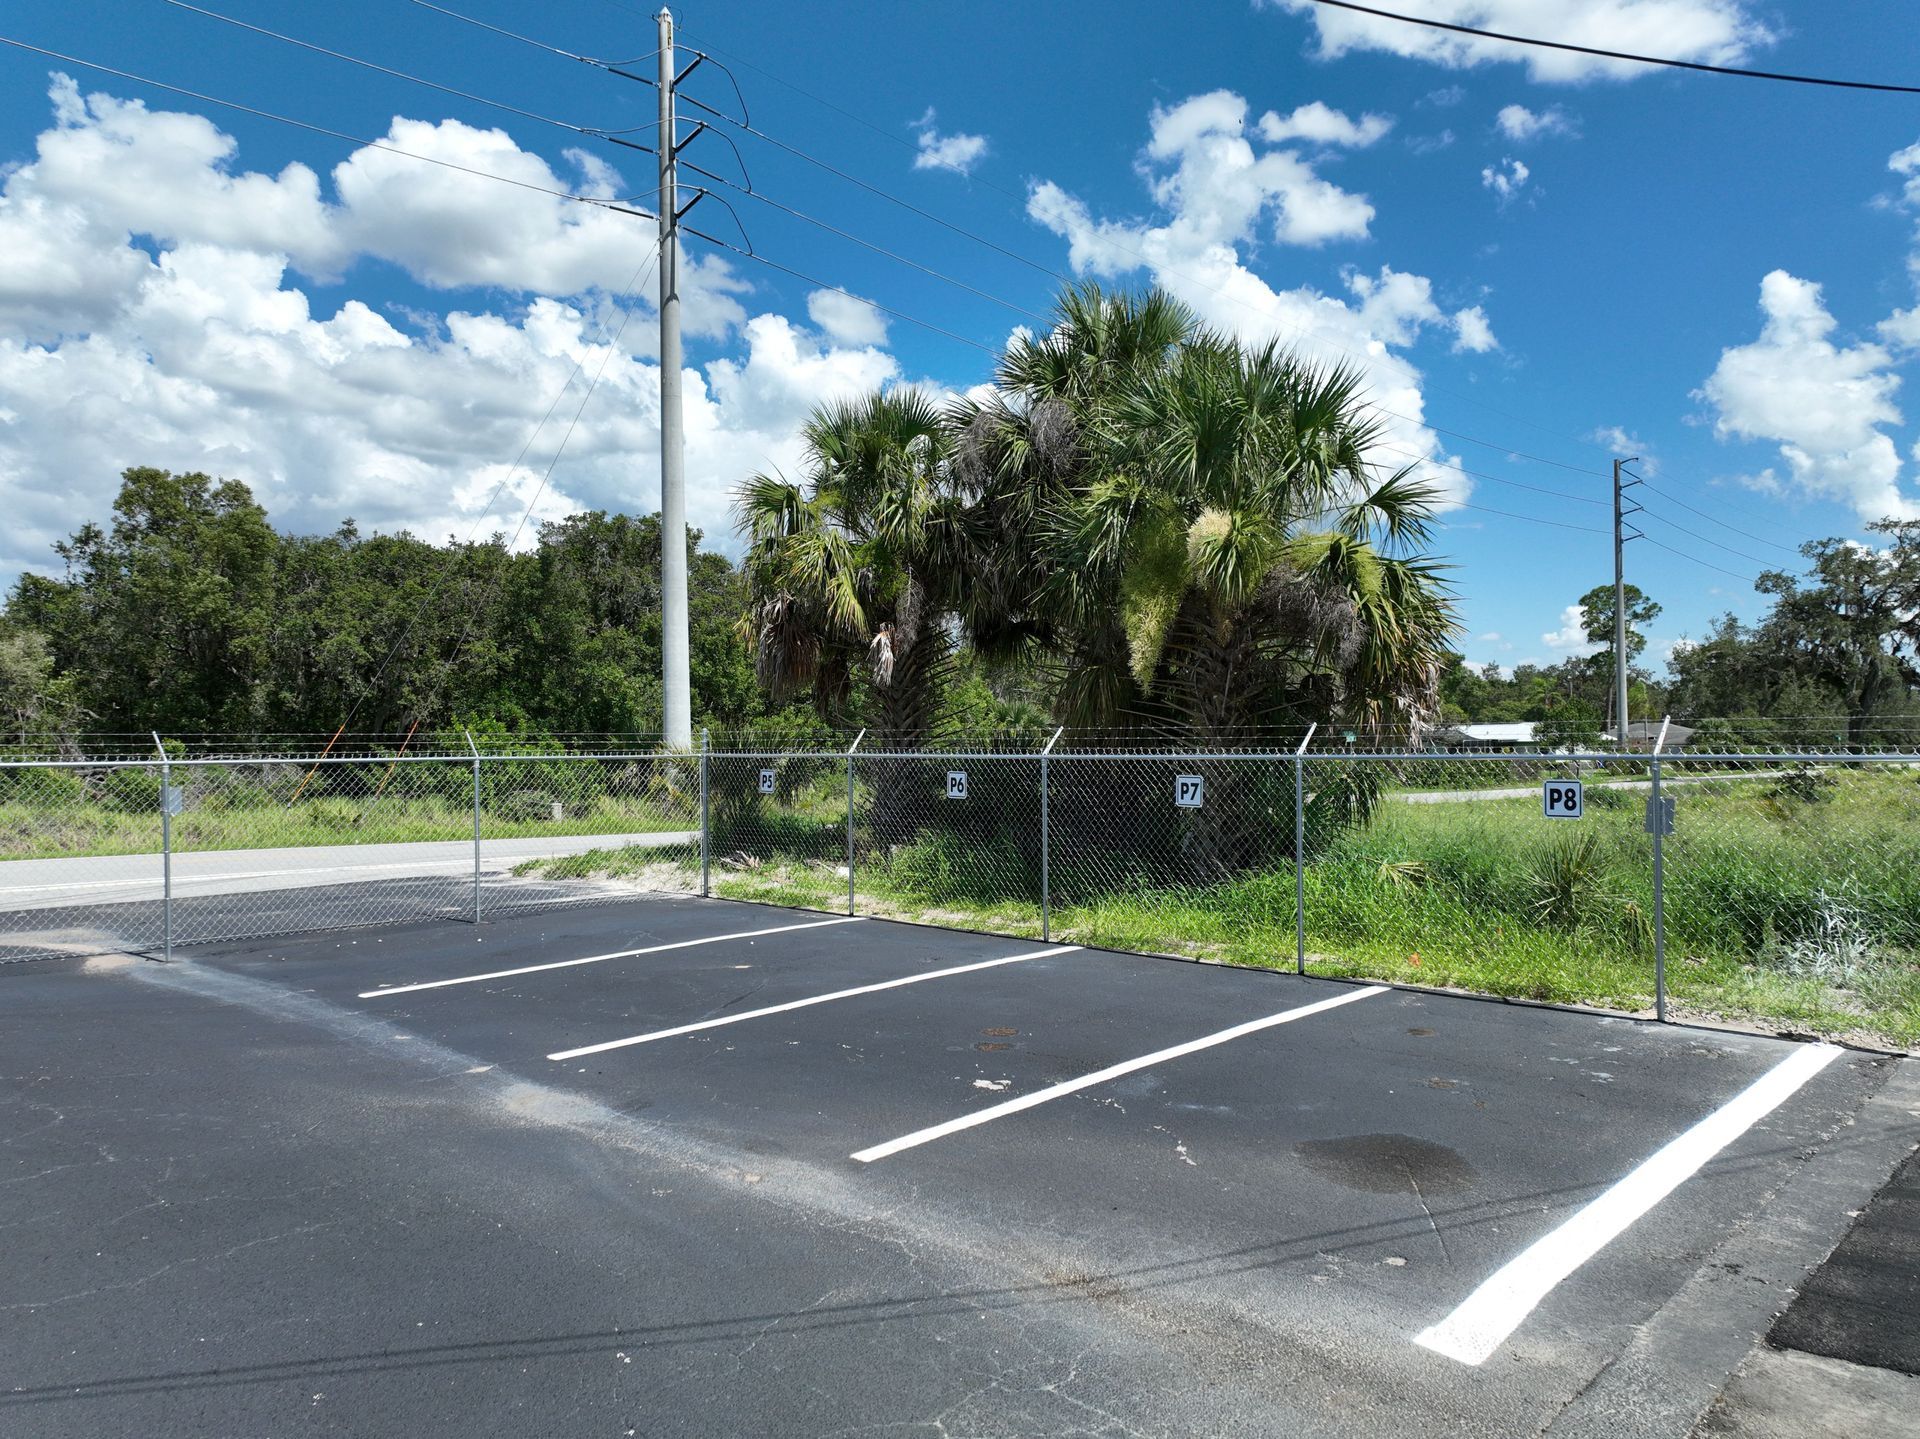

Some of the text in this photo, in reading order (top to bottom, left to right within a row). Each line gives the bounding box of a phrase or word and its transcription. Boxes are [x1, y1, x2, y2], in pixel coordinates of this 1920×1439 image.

[762, 774, 772, 788] P5
[950, 777, 964, 793] P6
[1180, 782, 1199, 800] P7
[1549, 788, 1577, 811] P8
